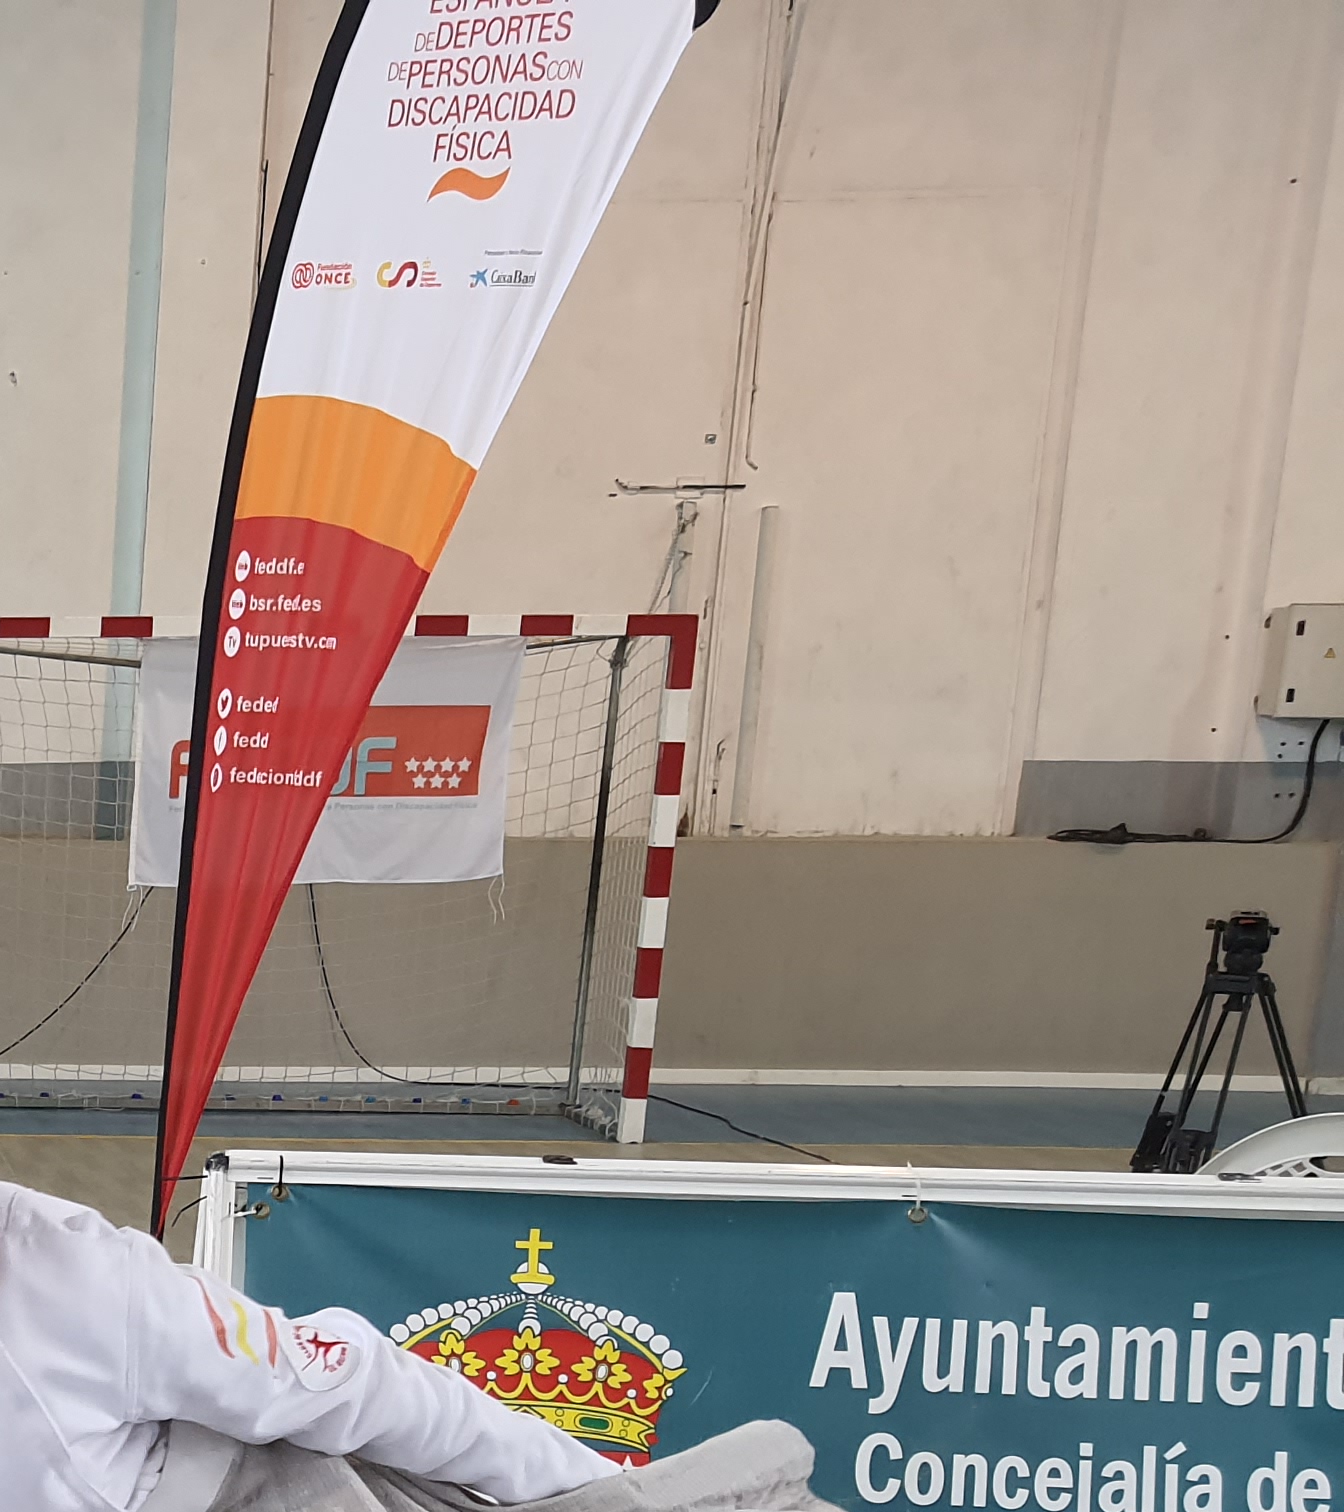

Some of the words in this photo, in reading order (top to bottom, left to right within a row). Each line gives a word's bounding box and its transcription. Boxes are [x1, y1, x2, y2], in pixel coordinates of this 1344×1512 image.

[387, 88, 576, 128] DISCAPACIDAD
[432, 124, 512, 163] FÍSICA
[314, 273, 352, 286] ONCE
[808, 1291, 1344, 1414] Ayuntamient
